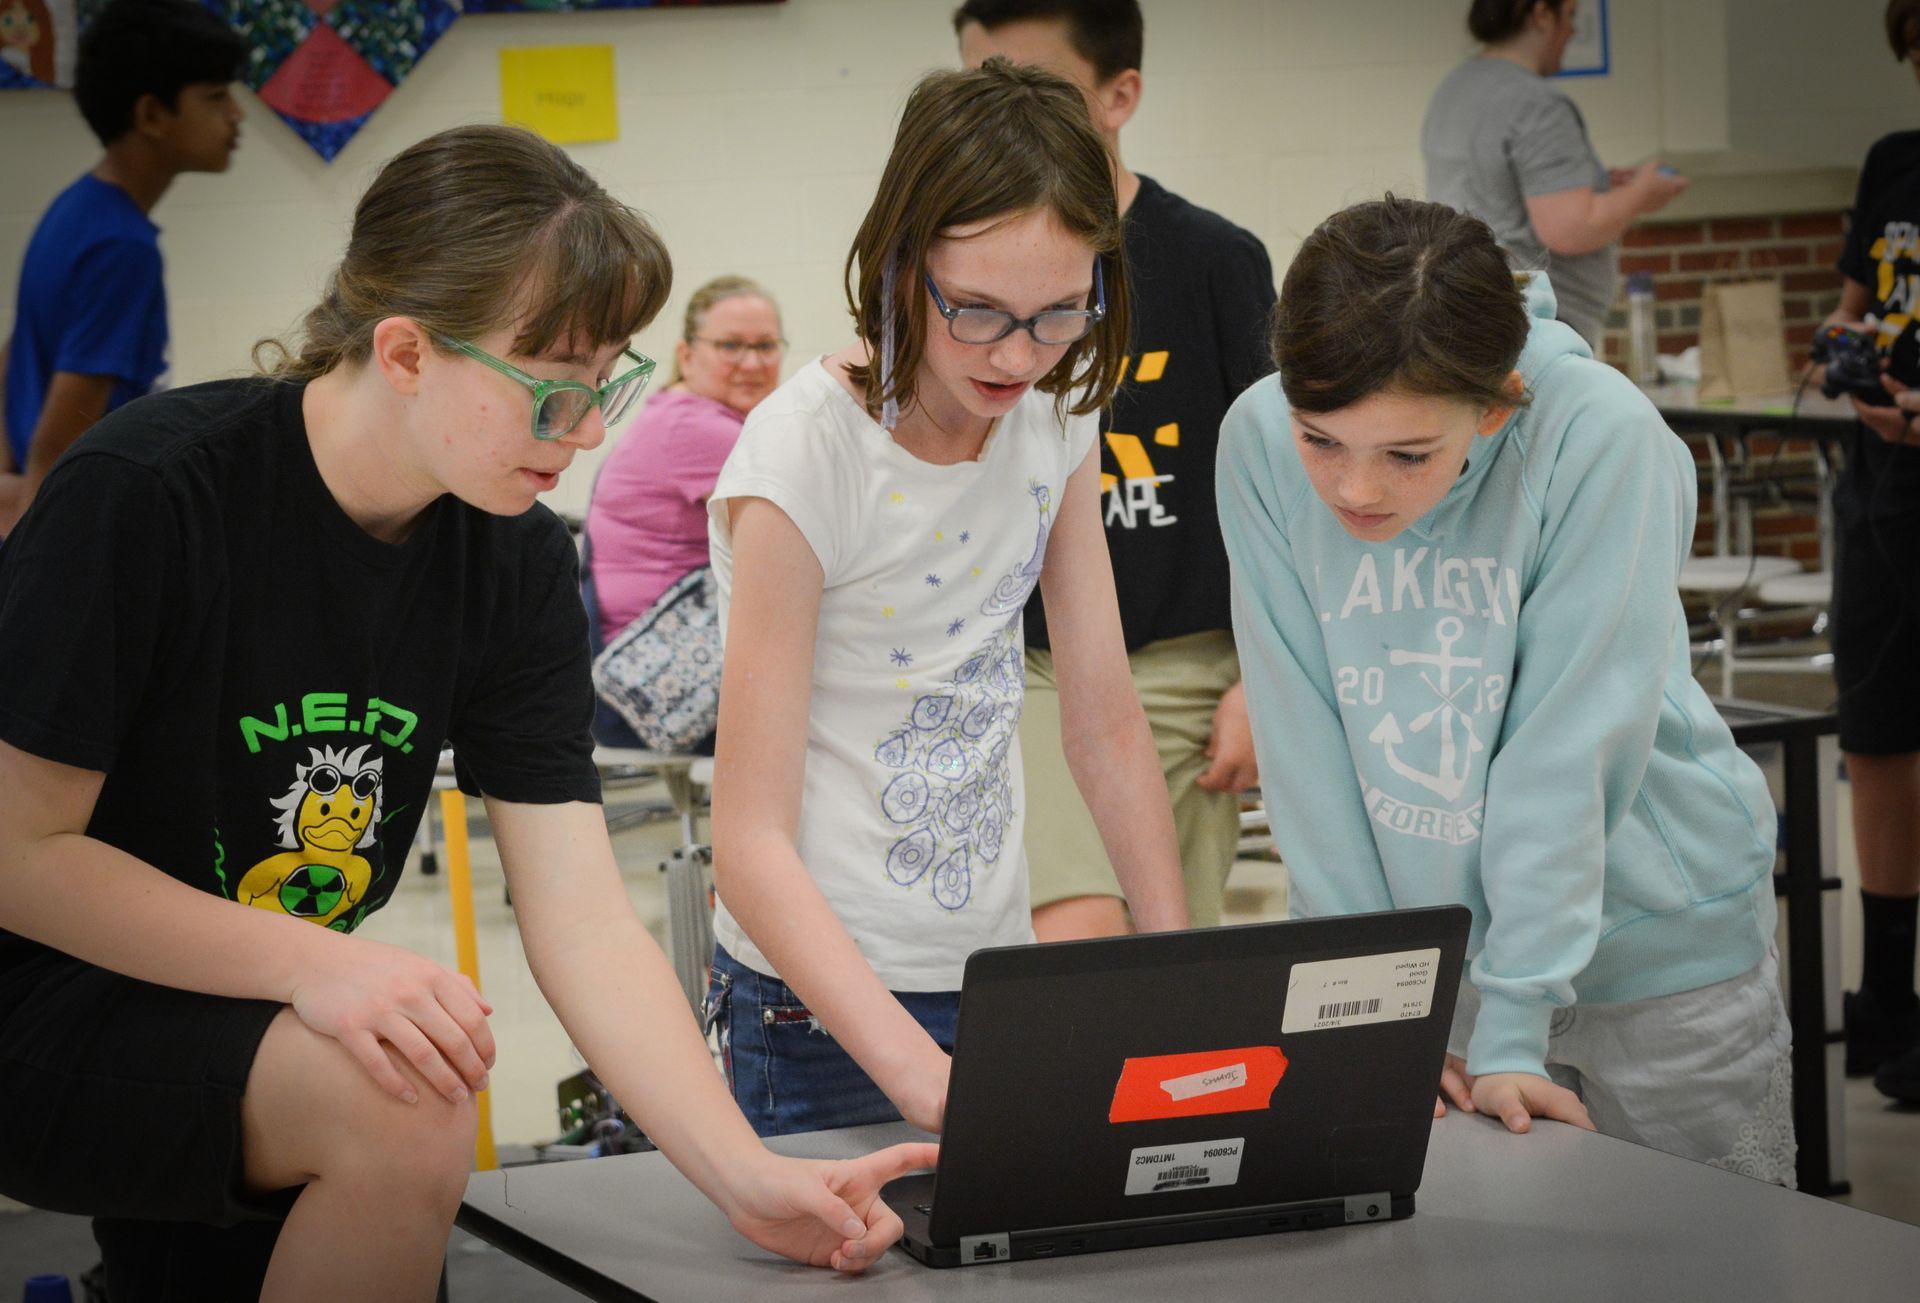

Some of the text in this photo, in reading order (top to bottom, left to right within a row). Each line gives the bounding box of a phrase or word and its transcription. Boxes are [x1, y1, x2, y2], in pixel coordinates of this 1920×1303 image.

[1337, 666, 1385, 705] 20
[1395, 962, 1418, 970] Wiped
[1135, 1146, 1239, 1165] PC60094 1MTDMC2
